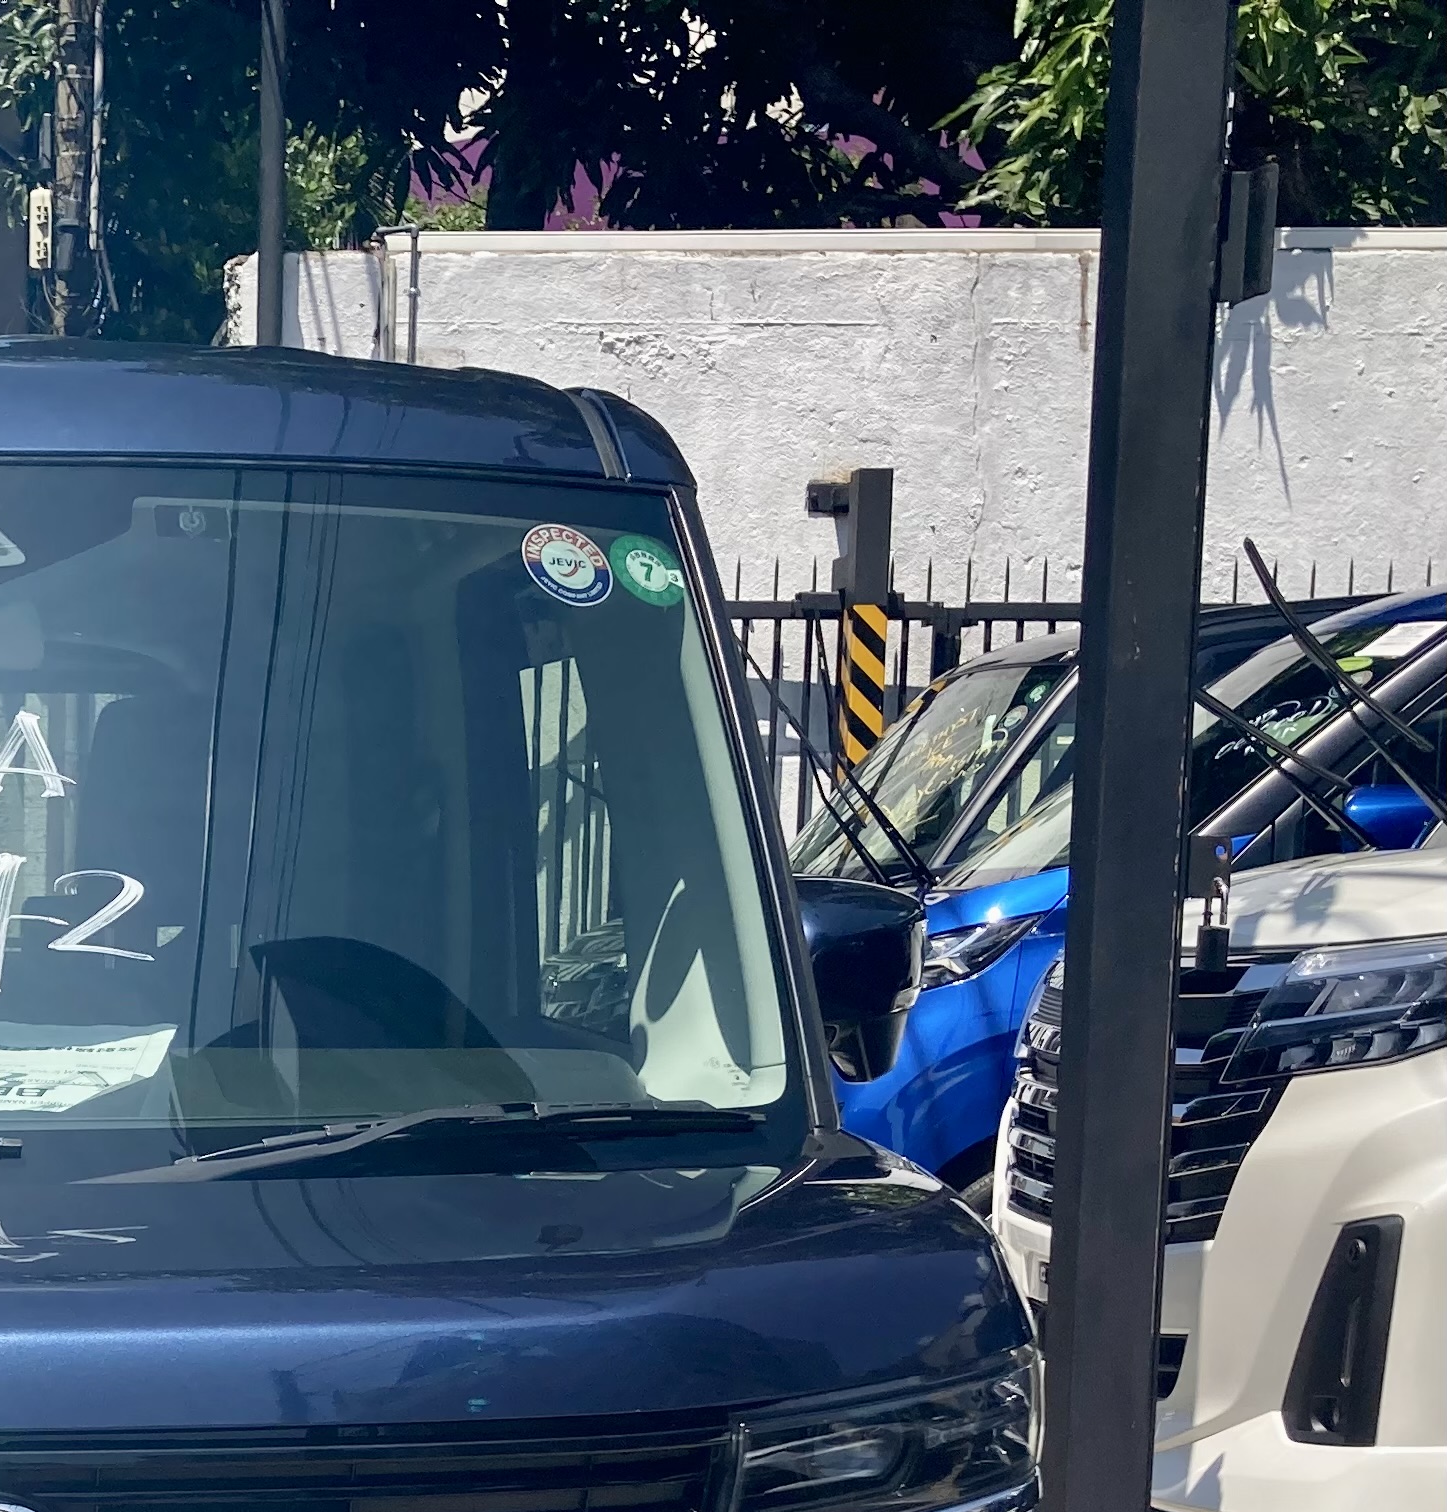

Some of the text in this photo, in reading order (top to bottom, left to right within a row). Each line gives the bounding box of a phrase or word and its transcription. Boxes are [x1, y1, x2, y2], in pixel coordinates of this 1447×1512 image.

[526, 528, 604, 567] INSPECTED
[549, 557, 587, 569] JEVIC
[639, 561, 653, 582] 7
